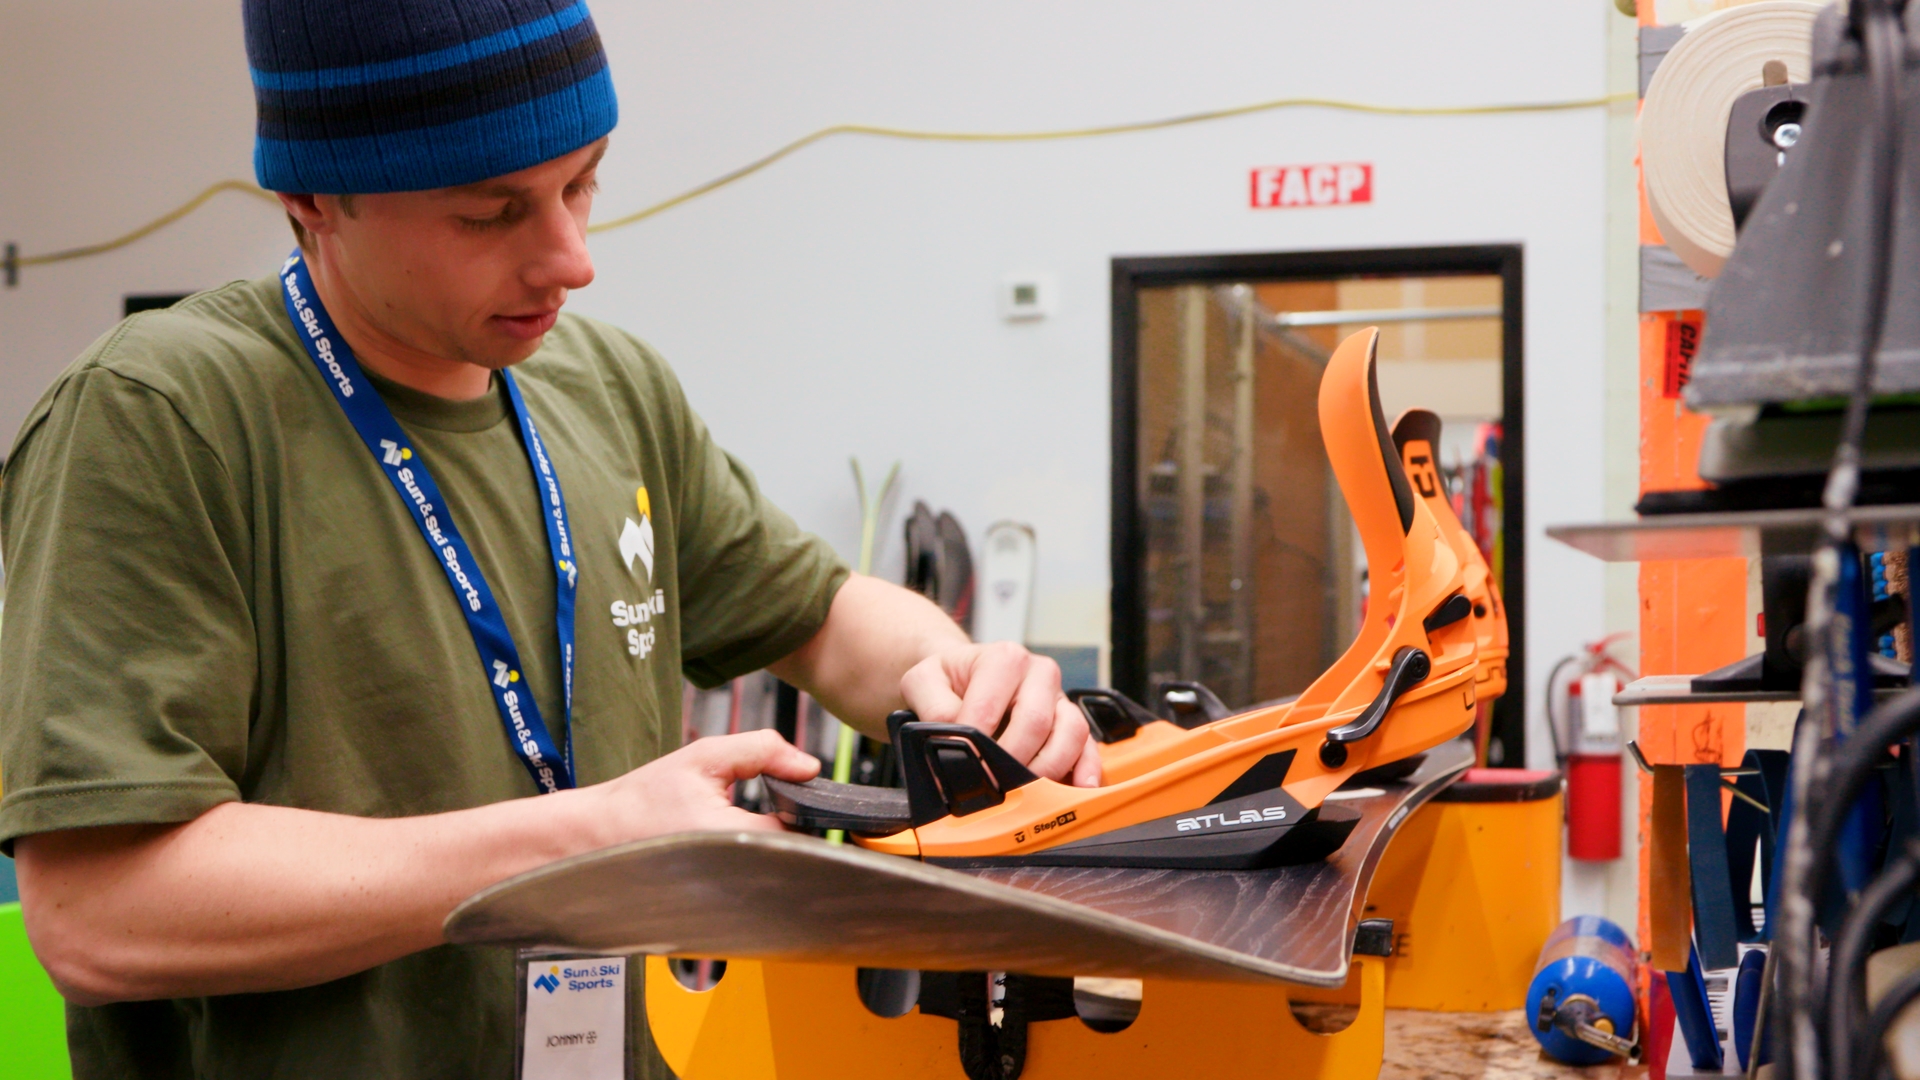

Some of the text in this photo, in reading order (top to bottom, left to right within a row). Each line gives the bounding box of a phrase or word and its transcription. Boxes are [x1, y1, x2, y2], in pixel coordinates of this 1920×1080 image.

[1257, 165, 1366, 205] FACP
[315, 337, 355, 398] Sports
[443, 545, 482, 613] Sports
[1176, 805, 1287, 832] ATLAS
[568, 978, 614, 992] Sports
[546, 1033, 585, 1048] JOHNNY
